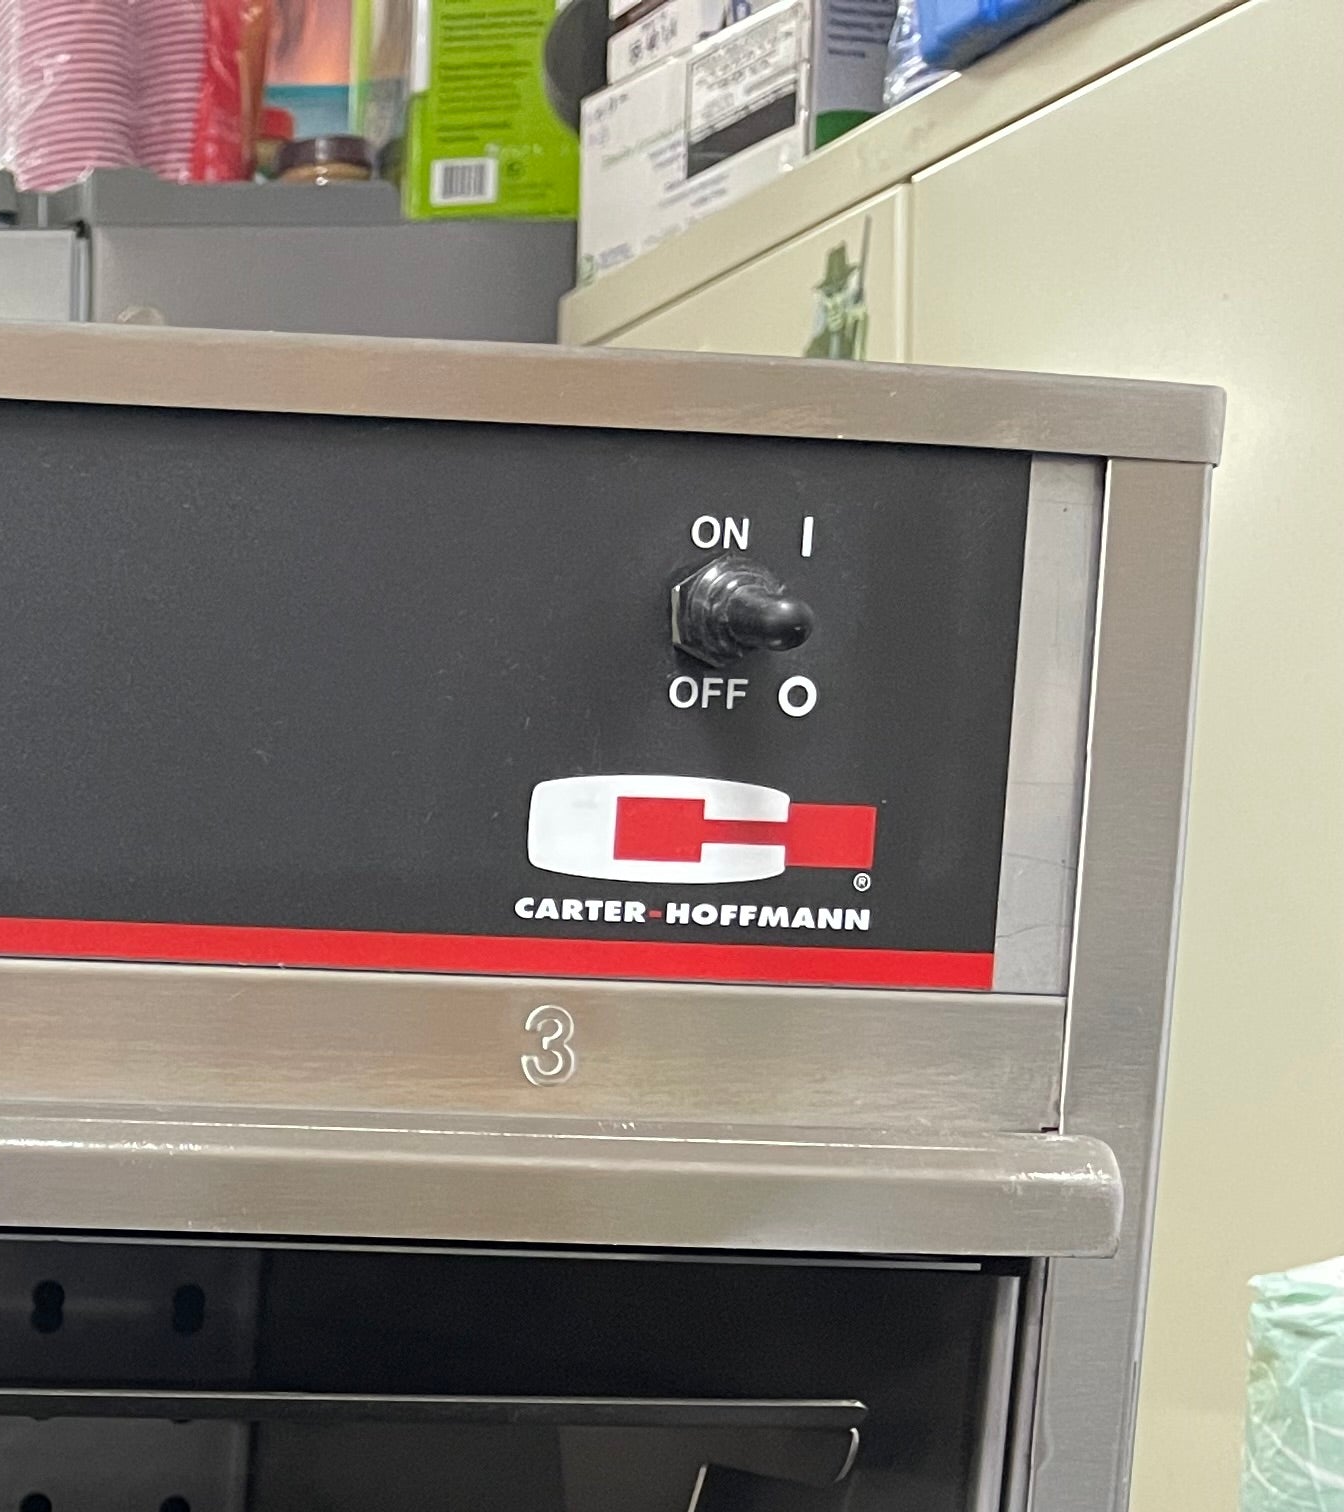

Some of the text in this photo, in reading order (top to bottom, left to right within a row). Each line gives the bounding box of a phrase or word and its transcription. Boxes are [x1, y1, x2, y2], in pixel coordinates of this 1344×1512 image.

[690, 514, 751, 550] ON
[667, 674, 750, 710] OFF
[513, 896, 872, 931] CARTER-HOFFMANN
[520, 1003, 576, 1088] 3
